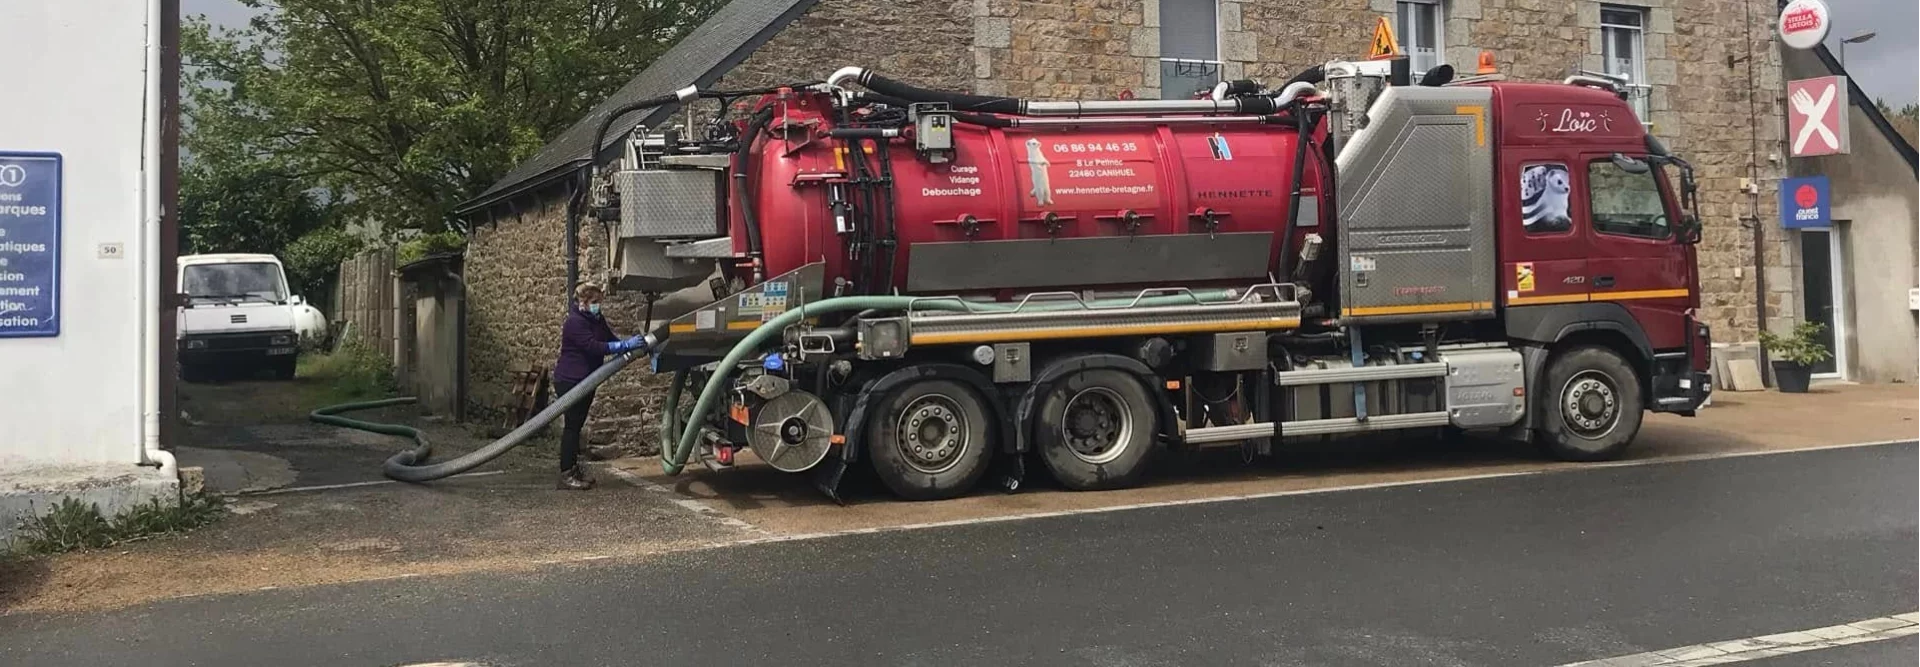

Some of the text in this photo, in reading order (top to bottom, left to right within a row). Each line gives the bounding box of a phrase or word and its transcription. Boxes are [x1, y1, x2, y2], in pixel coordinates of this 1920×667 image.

[1788, 13, 1813, 24] STELLA
[1788, 20, 1813, 29] ARTOIS
[1552, 108, 1598, 132] Loïc
[1053, 142, 1137, 153] 06 86 94 46 35
[1084, 159, 1095, 167] Le
[950, 165, 978, 174] Curage
[1068, 168, 1136, 178] 22480 CANIHUEL
[949, 175, 980, 185] Vidange
[922, 187, 982, 197] Debouchage
[1055, 184, 1154, 195] www.hennette-bretagne.fr
[1197, 189, 1273, 199] HENNETTE
[104, 246, 117, 254] 50
